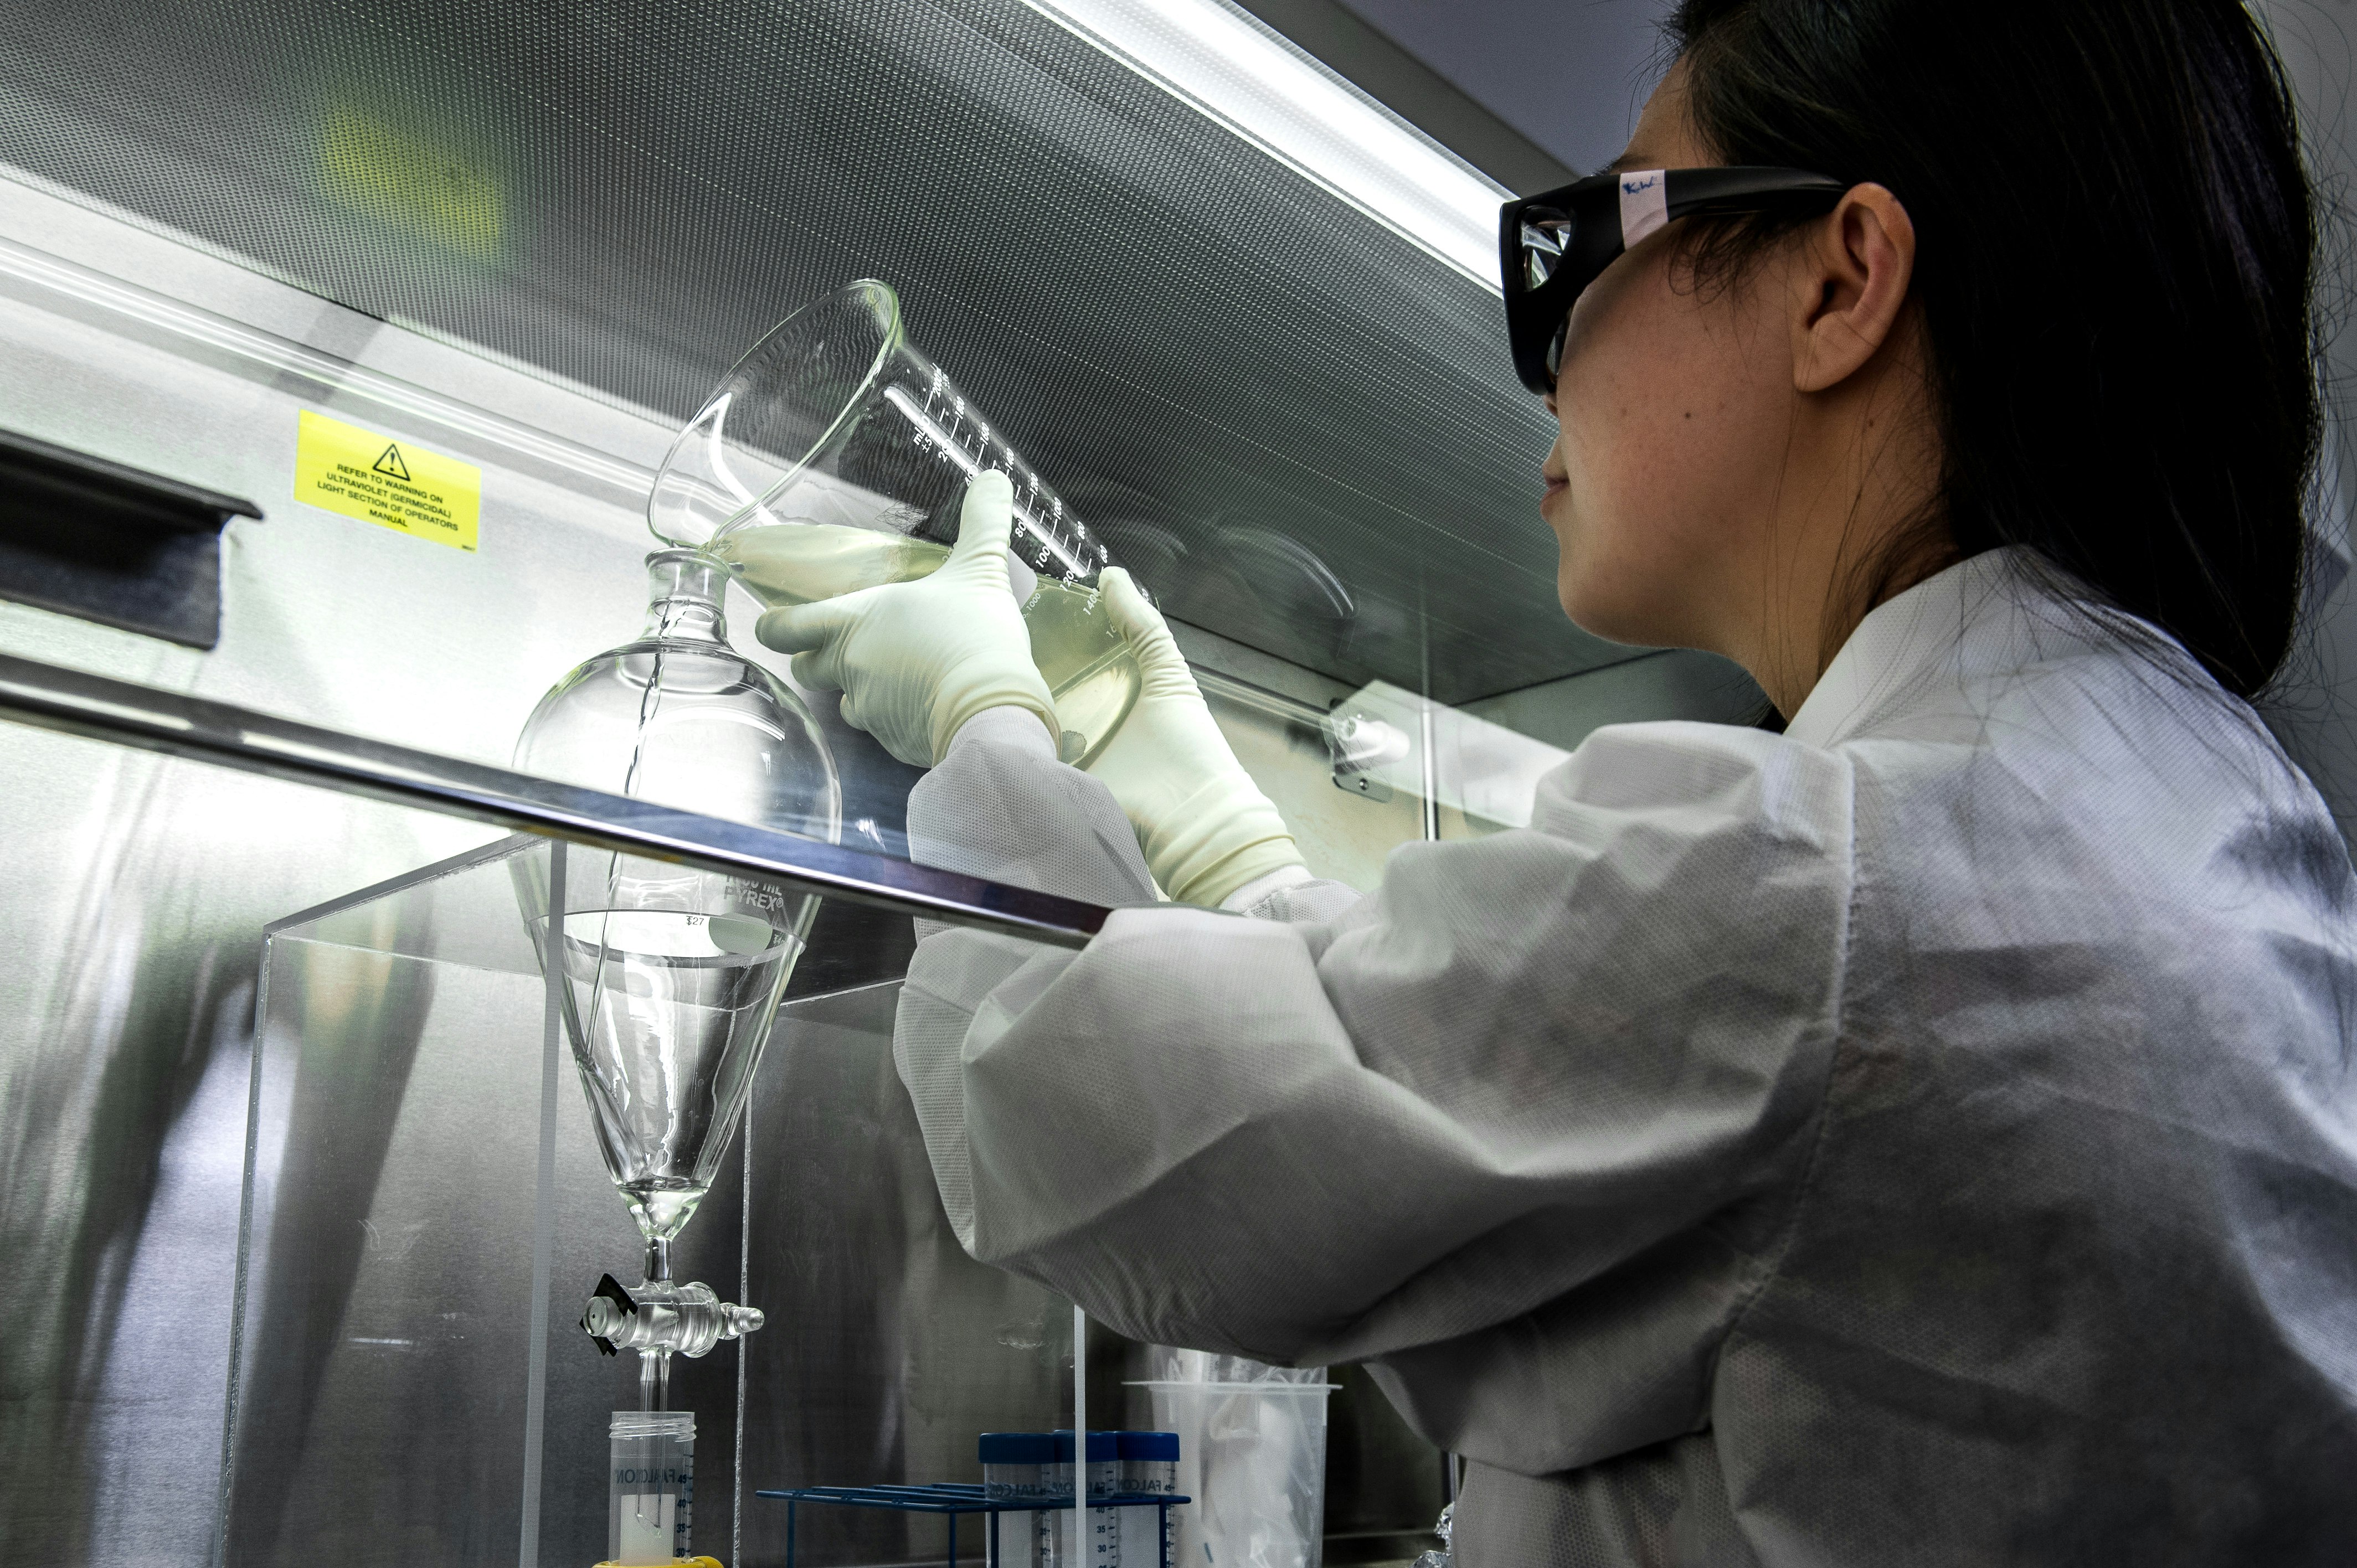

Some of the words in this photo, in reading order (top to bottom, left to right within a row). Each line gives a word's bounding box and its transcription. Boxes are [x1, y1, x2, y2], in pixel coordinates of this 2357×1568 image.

[932, 372, 943, 398] 2000
[913, 426, 927, 446] mL
[980, 421, 990, 446] 1600
[1005, 447, 1015, 471] 1400
[337, 463, 368, 479] REFER
[370, 473, 383, 484] TO
[385, 477, 428, 499] WARNING
[430, 494, 444, 504] ON
[1030, 472, 1039, 496] 1200
[327, 472, 388, 497] ULTRAVIOLET
[390, 492, 451, 519] (GERMICIDAL)
[317, 481, 345, 496] LIGHT
[347, 491, 388, 509] SECTION
[390, 502, 403, 513] OF
[405, 508, 459, 532] OPERATORS
[1053, 497, 1062, 520] 1000
[369, 509, 408, 528] MANUAL
[1077, 520, 1085, 540] 800
[1099, 544, 1108, 564] 600
[1026, 592, 1041, 611] 1000
[677, 1474, 687, 1484] 45
[1164, 1484, 1171, 1492] 45
[677, 1498, 687, 1508] 40
[676, 1523, 686, 1533] 35
[1097, 1525, 1106, 1534] 35
[675, 1548, 685, 1557] 30
[1098, 1544, 1107, 1553] 30
